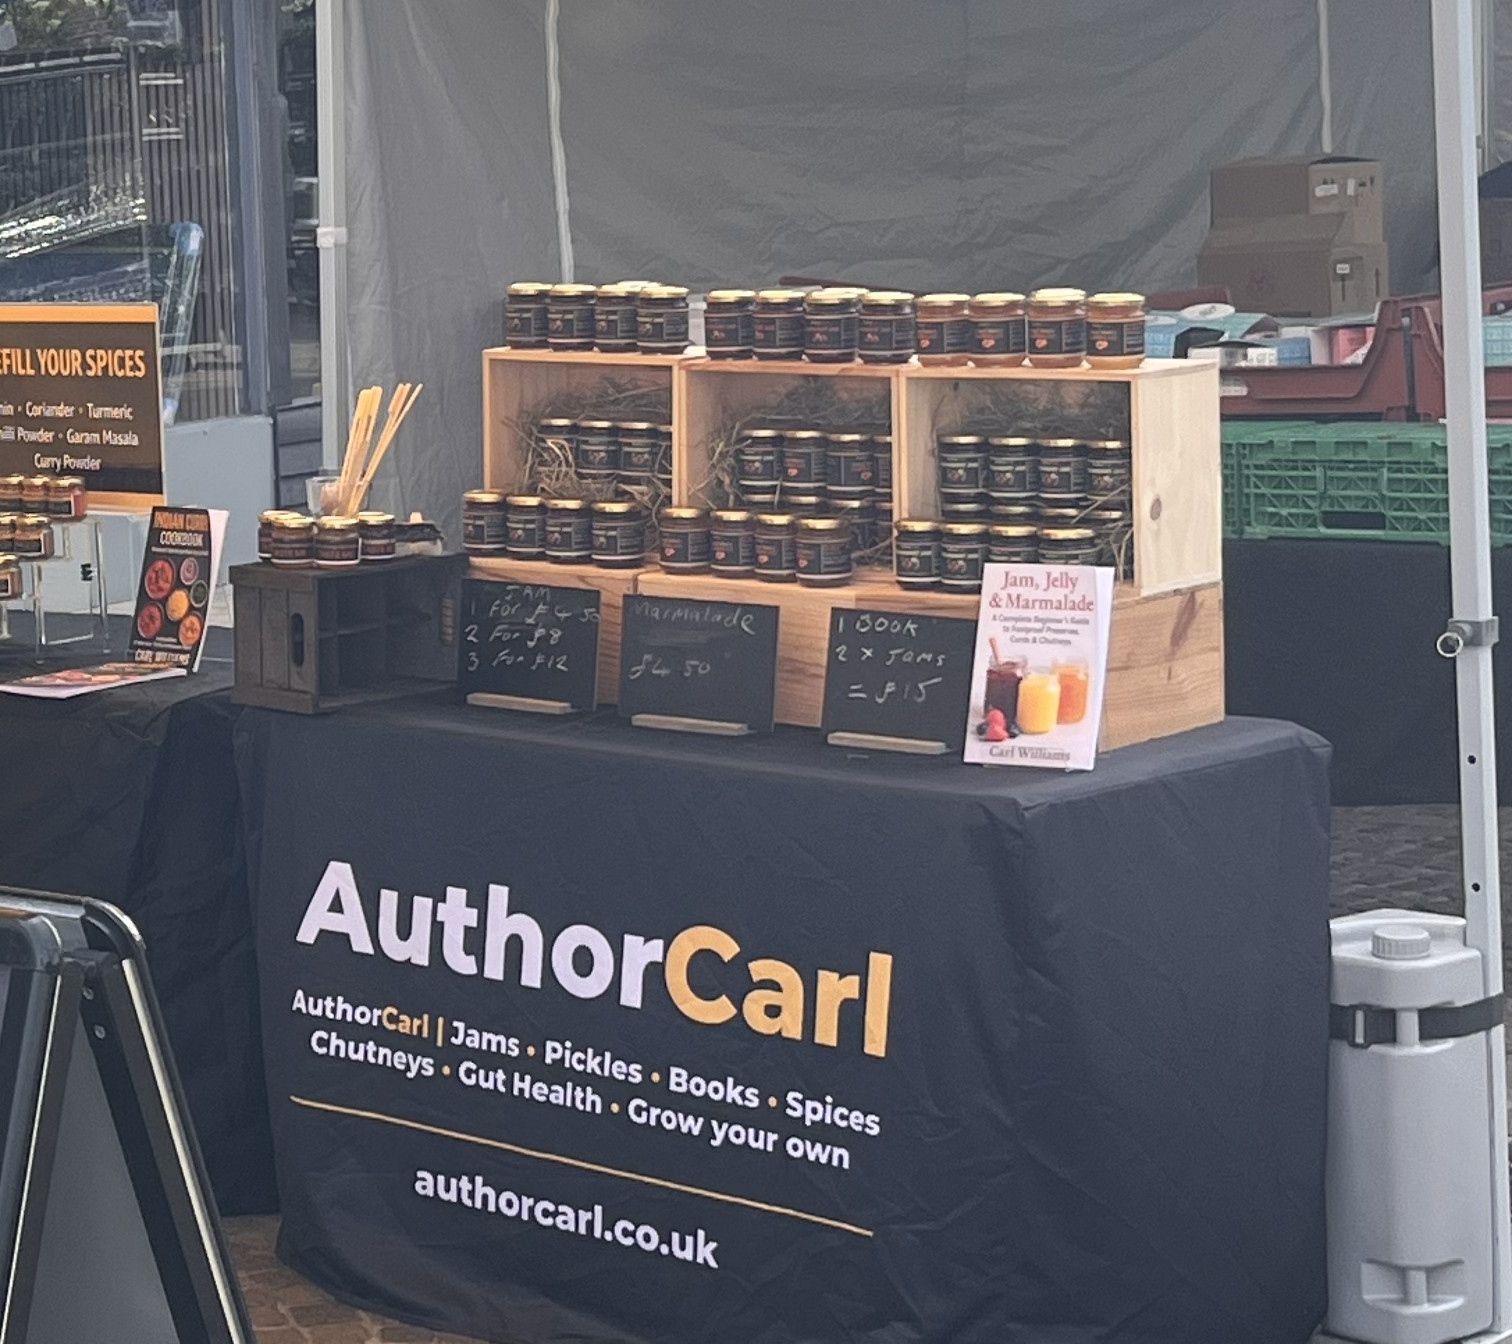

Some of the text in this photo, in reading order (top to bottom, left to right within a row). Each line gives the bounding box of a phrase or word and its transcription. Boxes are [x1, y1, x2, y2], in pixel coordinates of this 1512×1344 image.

[37, 348, 83, 377] YOUR
[85, 349, 146, 378] SPICES
[26, 401, 75, 417] Coriander
[86, 403, 133, 420] Turmeric
[17, 427, 54, 443] Powder
[66, 428, 100, 444] Garam
[102, 429, 139, 446] Masala
[34, 453, 101, 472] Curry Powder
[1000, 571, 1078, 594] Jam, Jelly
[505, 585, 551, 600] JAM
[989, 593, 1094, 612] & Marmalade
[464, 624, 479, 643] 2
[838, 616, 844, 633] 1
[467, 652, 480, 672] 3
[835, 644, 847, 662] 2
[295, 860, 893, 1058] AuthorCarl
[291, 988, 881, 1136] AuthorCarl Jams Pickles Books Spices
[310, 1030, 851, 1170] Chutneys Gut Health Grow your own
[414, 1168, 719, 1269] authorcarl.co.uk
